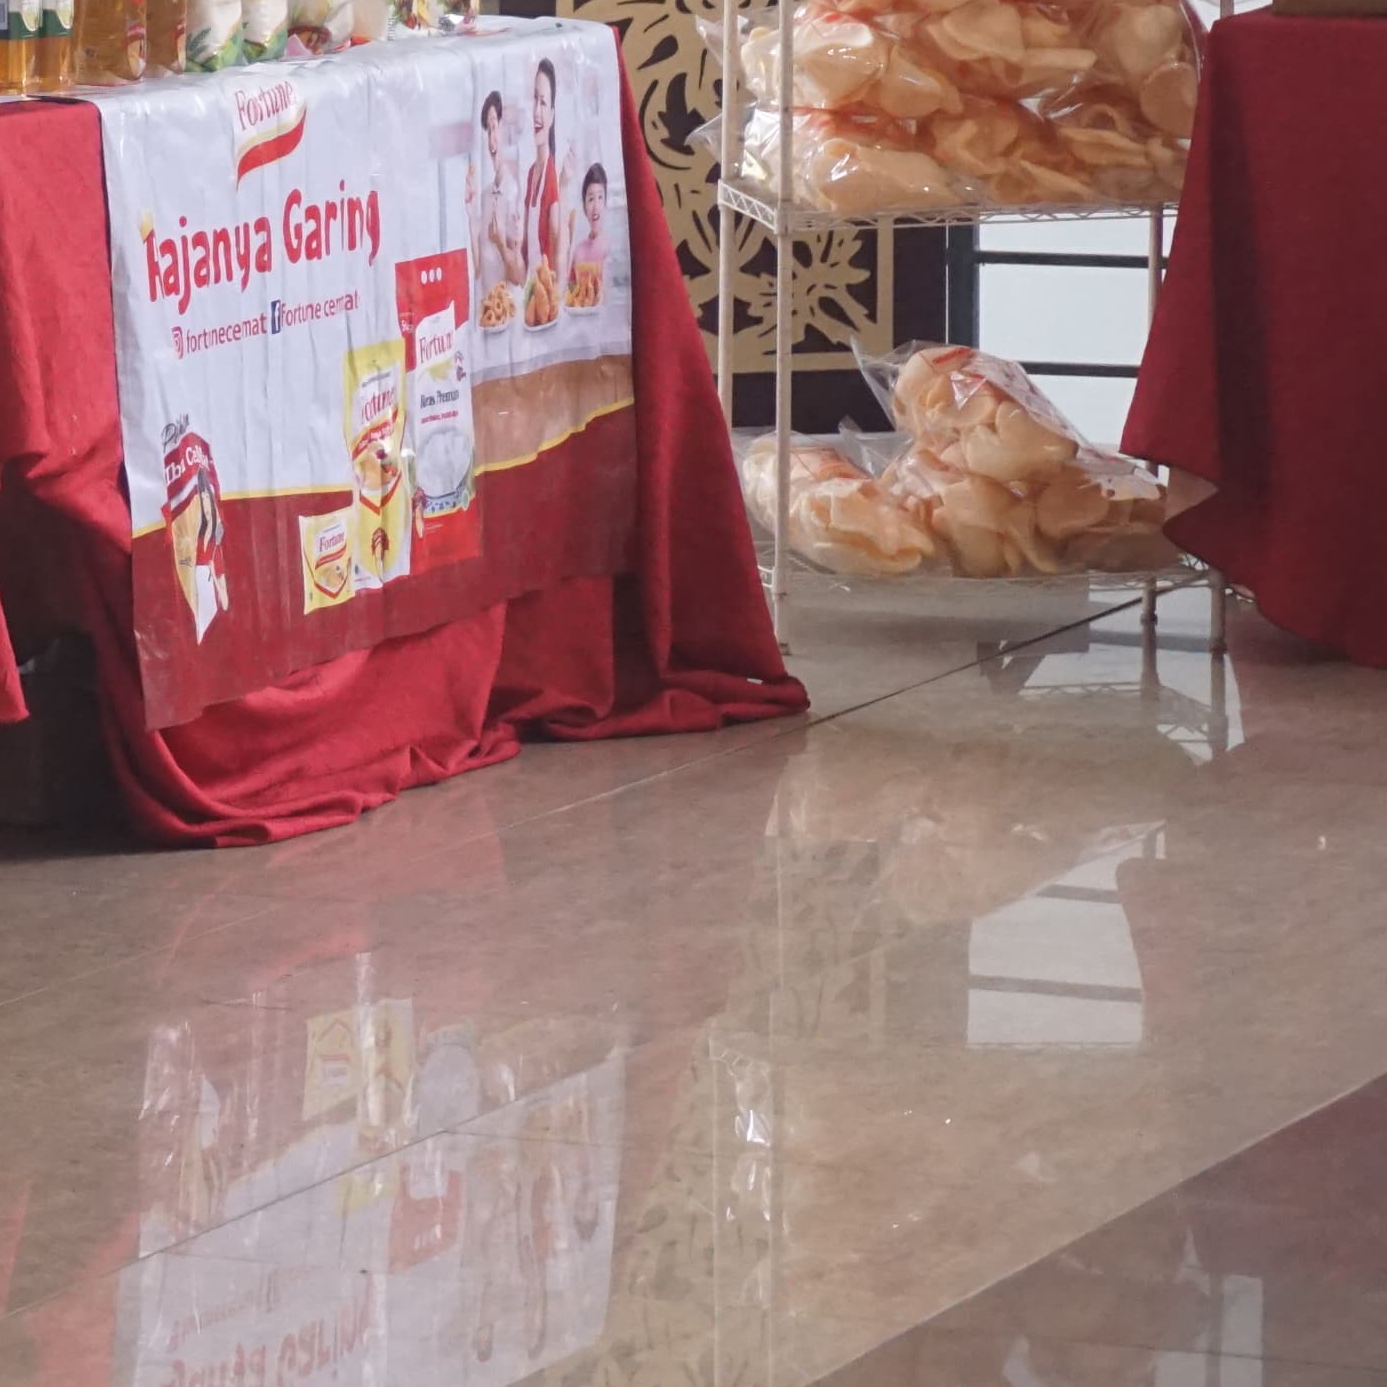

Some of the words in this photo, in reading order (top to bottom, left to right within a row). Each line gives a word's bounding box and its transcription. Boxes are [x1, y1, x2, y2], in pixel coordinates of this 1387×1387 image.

[234, 80, 293, 132] Fortune
[282, 179, 380, 267] Garing
[186, 313, 267, 354] fortnecemat
[419, 330, 454, 364] Fortun
